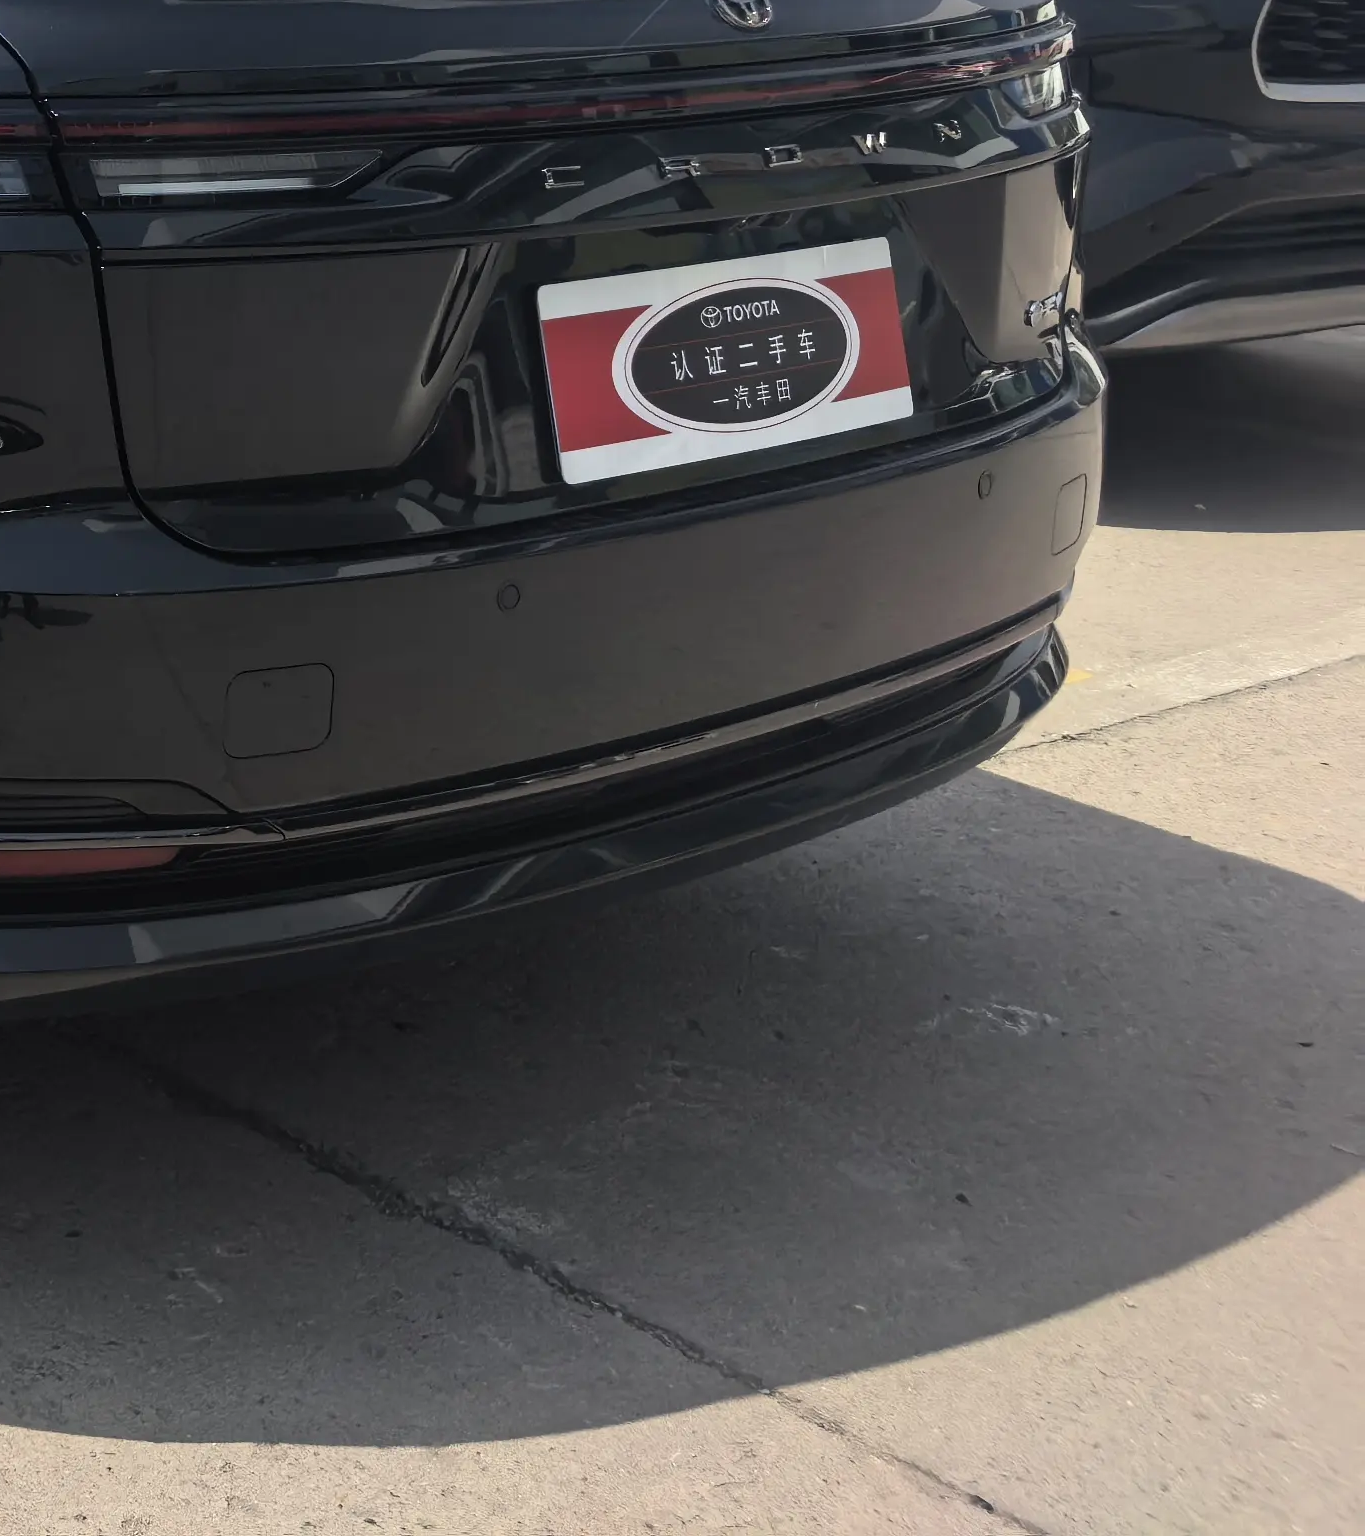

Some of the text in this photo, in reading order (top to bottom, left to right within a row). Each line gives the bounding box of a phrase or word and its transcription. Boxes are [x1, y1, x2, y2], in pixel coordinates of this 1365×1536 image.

[723, 299, 781, 323] TOYOTA
[670, 328, 817, 381] 认证二手车
[712, 378, 792, 410] 一汽丰田
